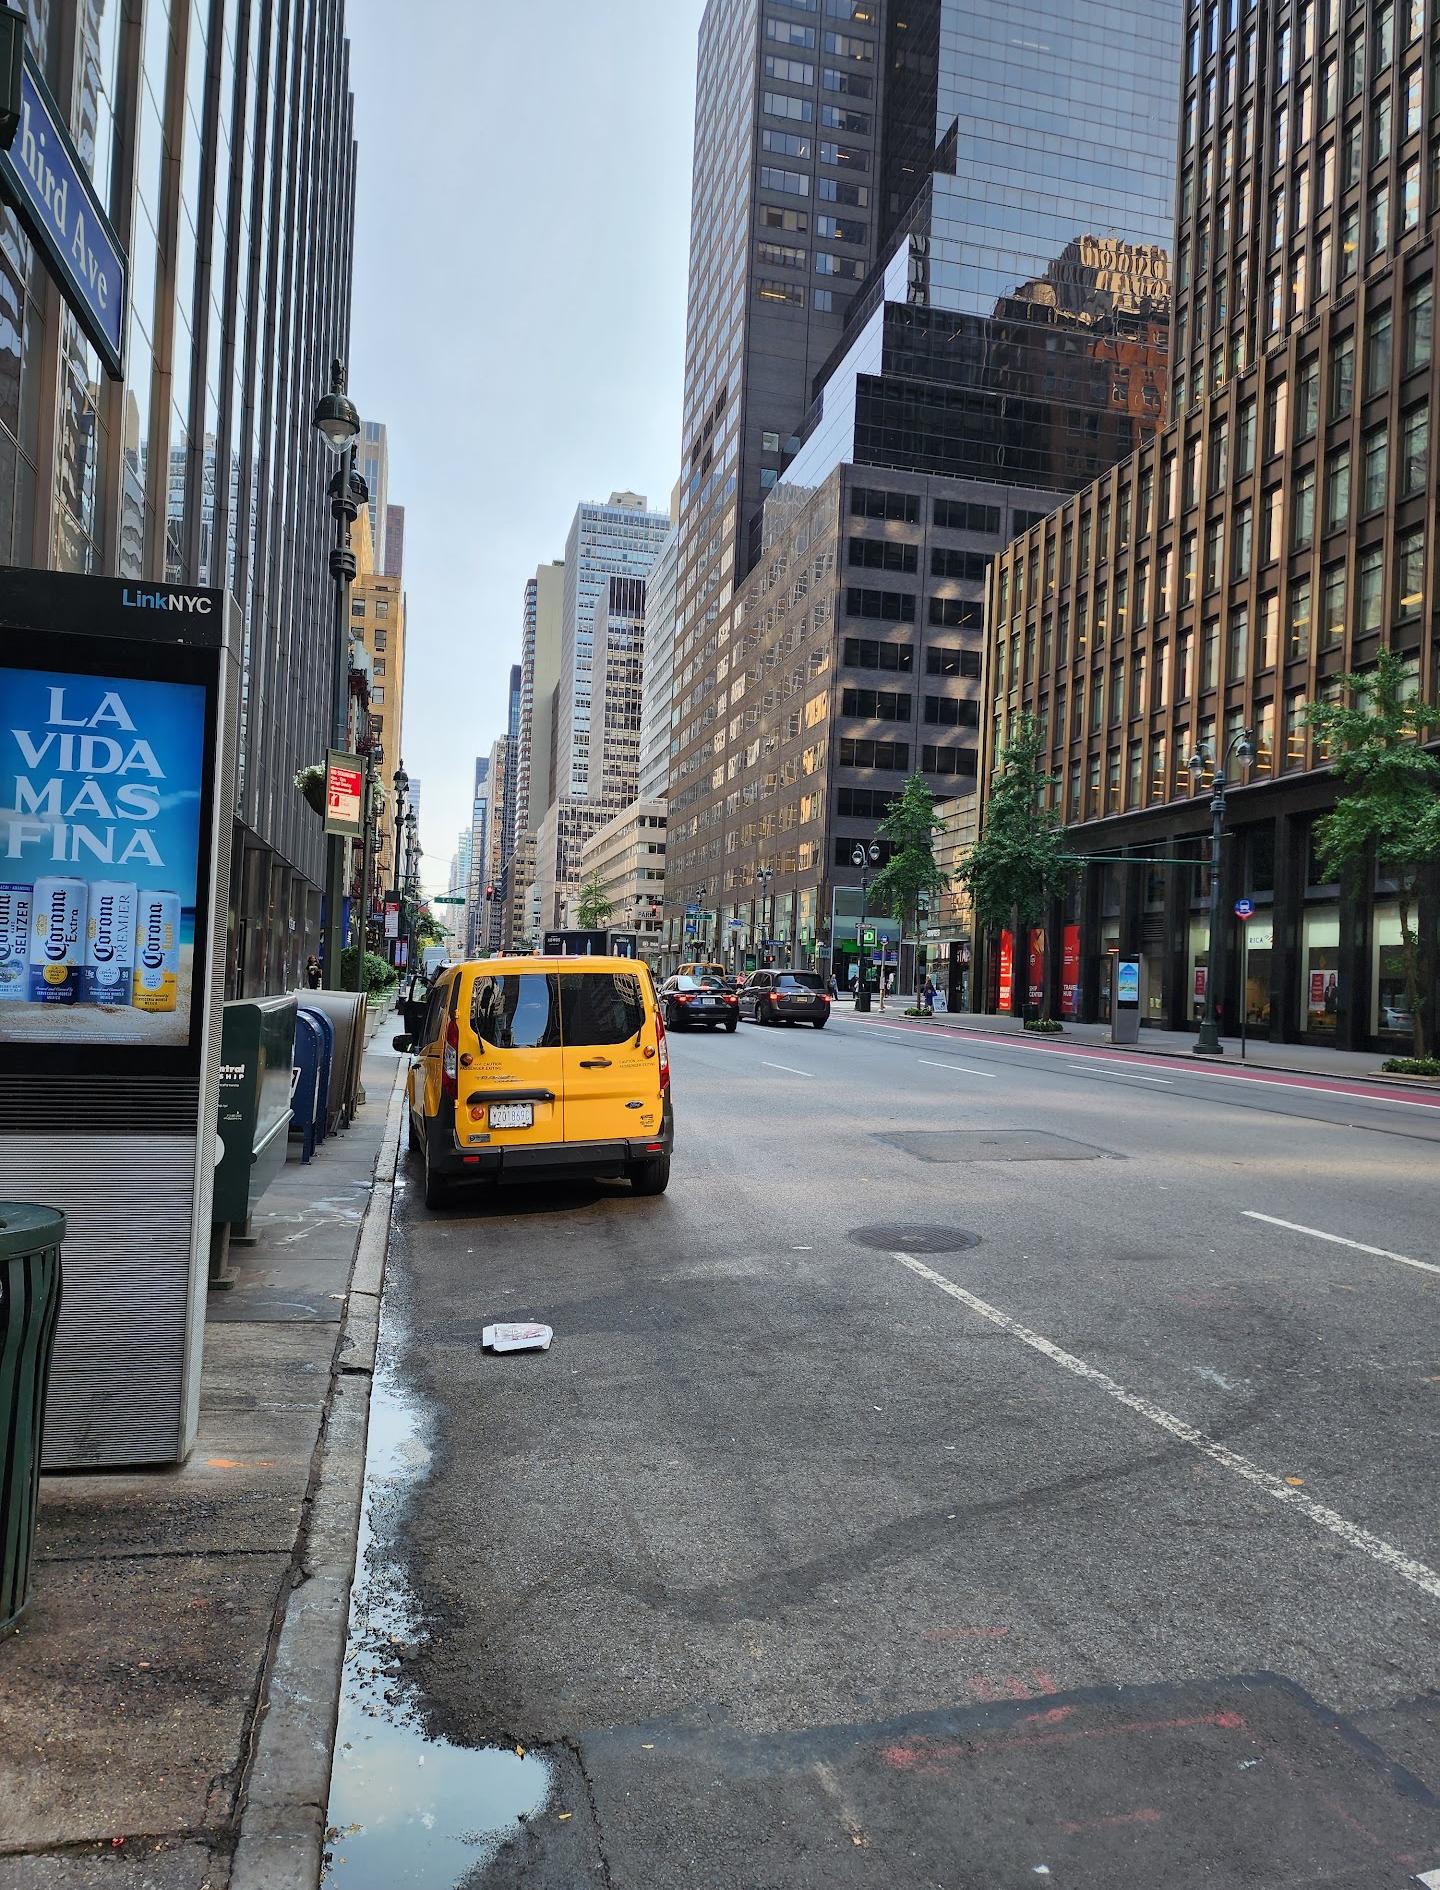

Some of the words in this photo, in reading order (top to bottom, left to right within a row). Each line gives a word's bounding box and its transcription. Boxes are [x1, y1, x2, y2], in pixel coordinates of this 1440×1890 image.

[21, 100, 68, 238] hird
[71, 210, 108, 309] Ave
[122, 588, 212, 614] LinkNYC
[44, 686, 138, 732] LA
[11, 729, 167, 779] VIDA
[13, 775, 161, 821] MÁS
[4, 821, 167, 867] FINA
[15, 901, 29, 955] SELTZER
[44, 889, 70, 961] Corona
[65, 909, 79, 943] Extra
[93, 896, 118, 962] Corona
[115, 895, 130, 962] PREMIER
[142, 902, 166, 969] Corona
[219, 1064, 245, 1073] ntral
